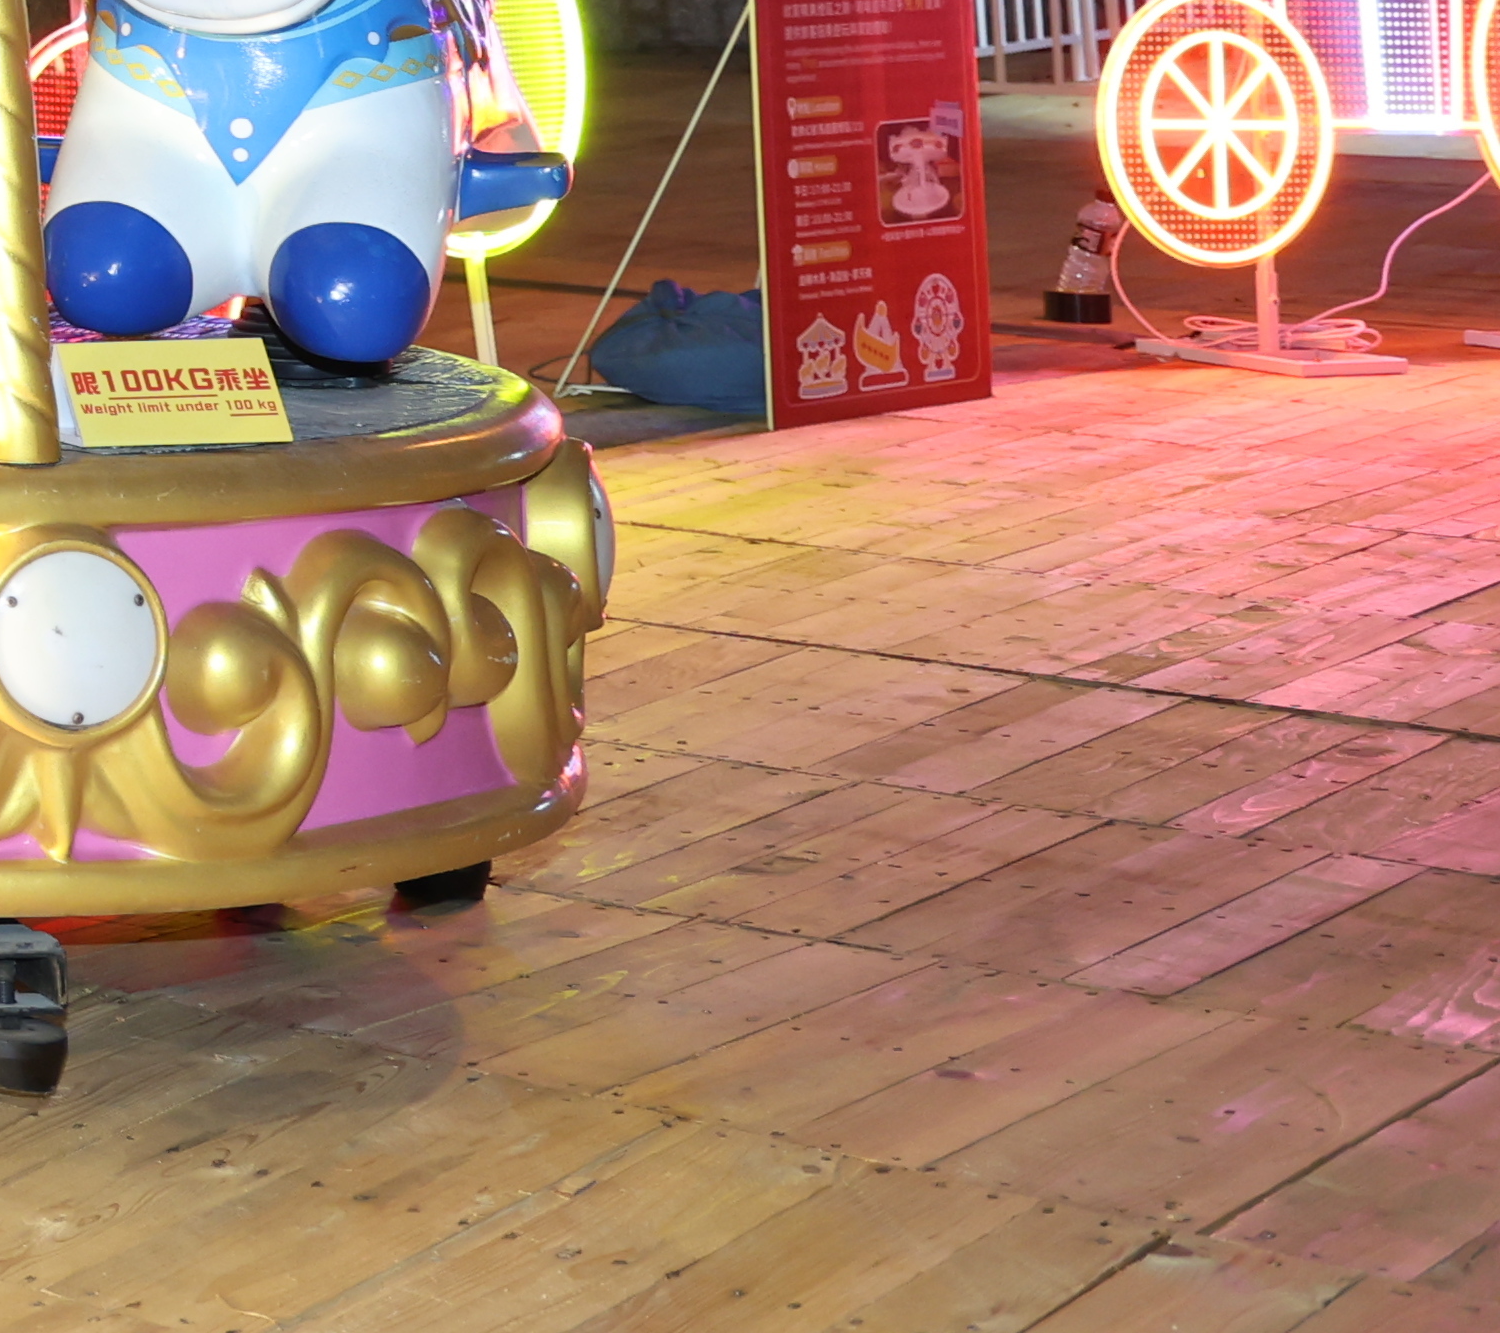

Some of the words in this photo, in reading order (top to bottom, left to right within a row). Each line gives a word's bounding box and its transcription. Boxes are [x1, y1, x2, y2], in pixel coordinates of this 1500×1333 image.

[80, 402, 134, 416] Weight
[138, 401, 172, 413] limit
[176, 401, 219, 412] under
[226, 399, 254, 411] 100
[258, 399, 278, 412] kg
